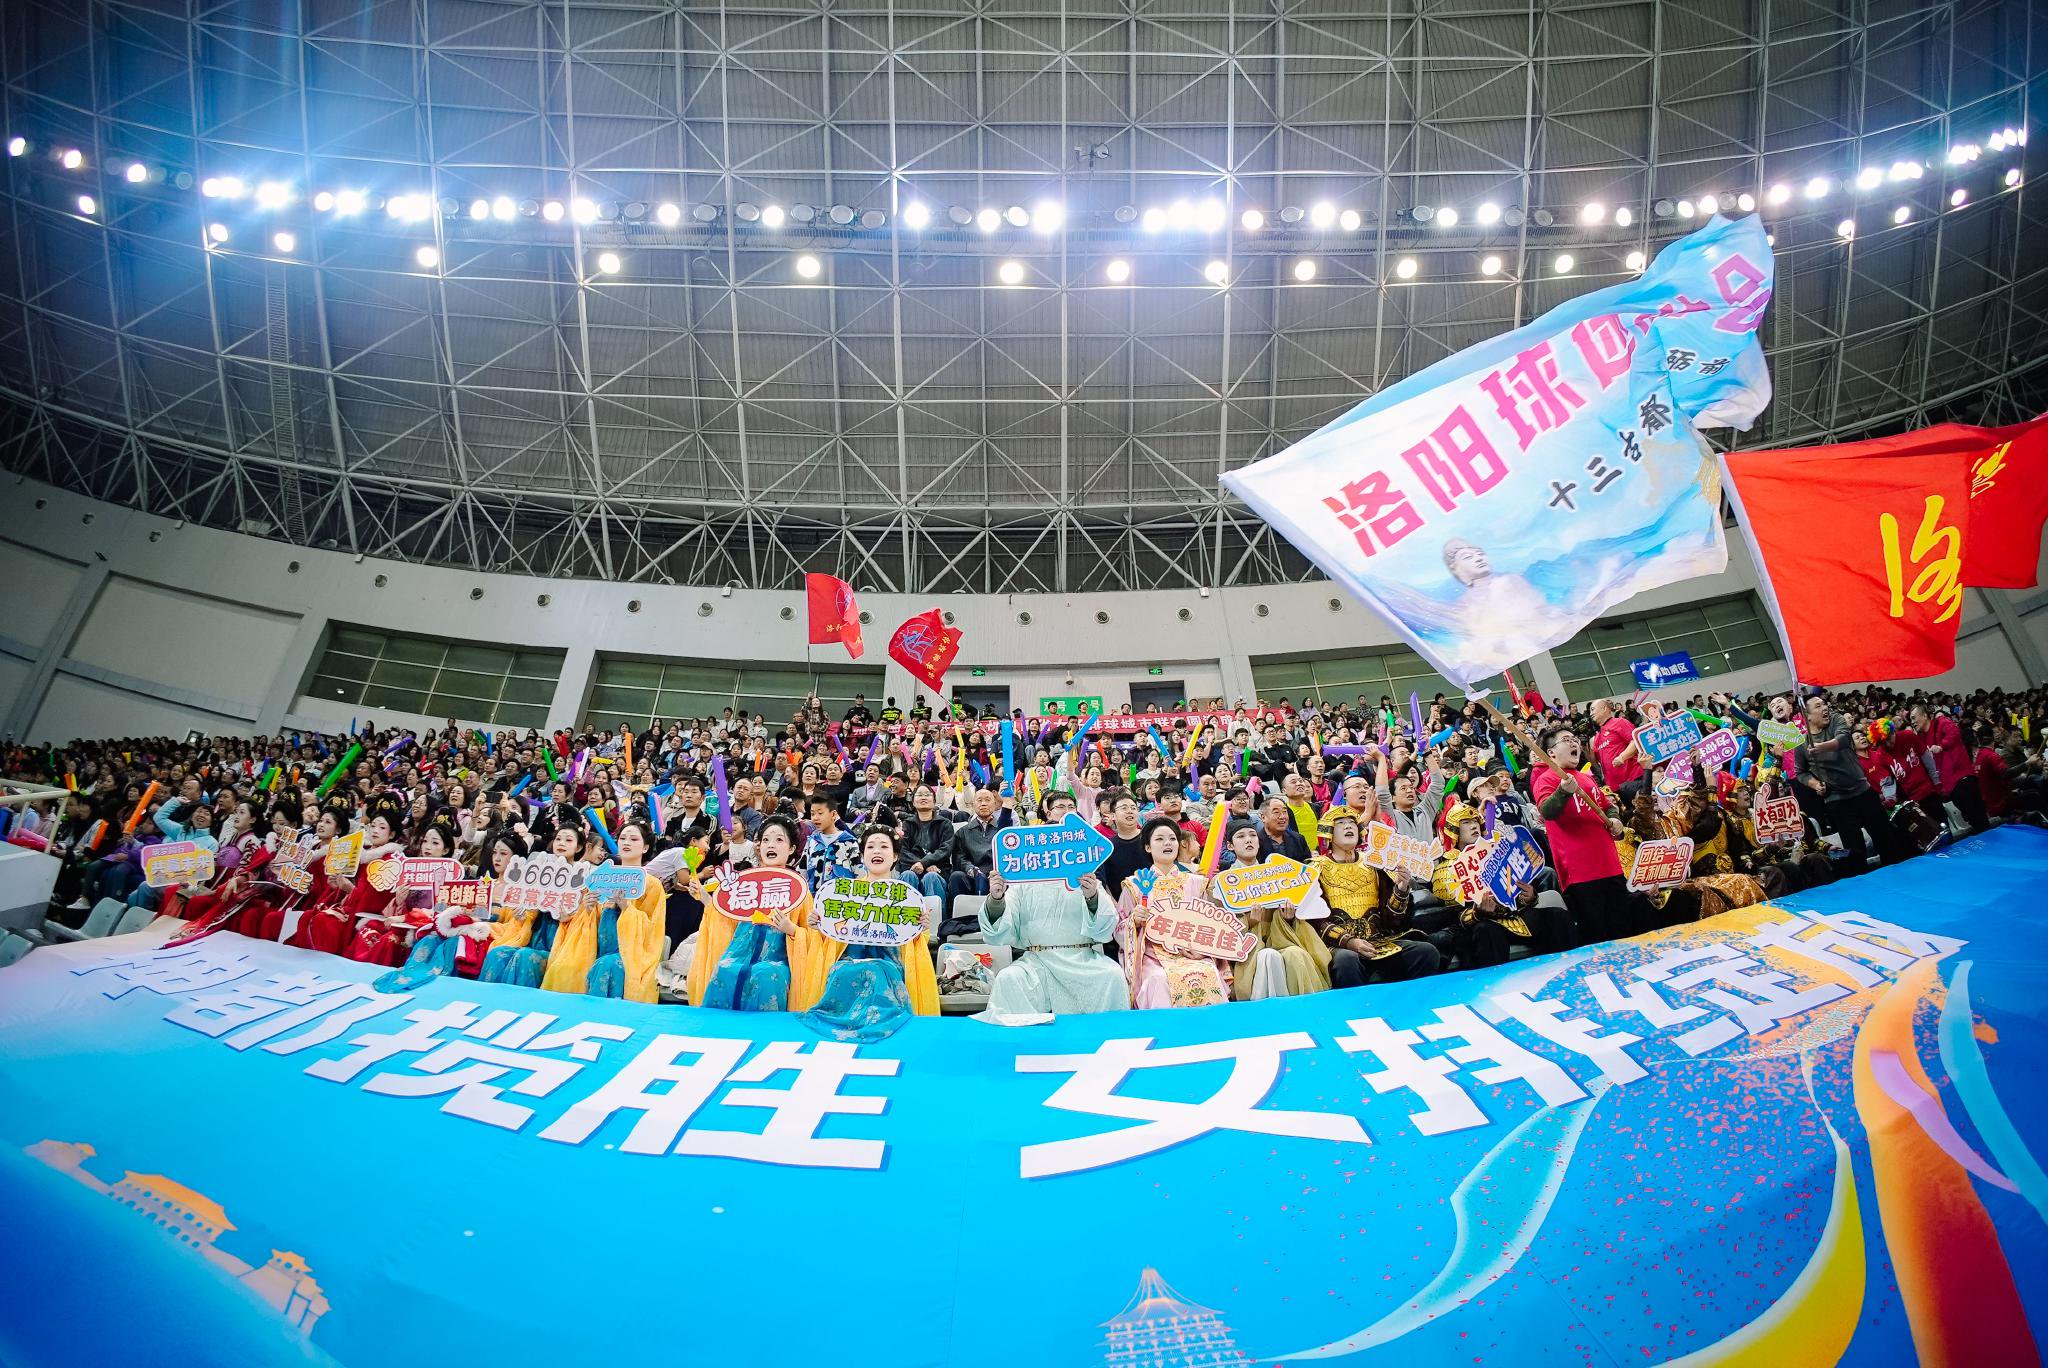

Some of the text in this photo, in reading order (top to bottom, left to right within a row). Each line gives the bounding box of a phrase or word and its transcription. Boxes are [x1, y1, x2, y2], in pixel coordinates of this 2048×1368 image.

[1757, 800, 1797, 825] 大有可为
[1024, 829, 1087, 846] 隋唐洛阳城
[1003, 846, 1101, 873] 为你打Call
[1640, 844, 1690, 864] 团结一心
[280, 863, 313, 892] NICE
[524, 864, 569, 888] 666
[1498, 847, 1532, 897] 必胜
[1634, 860, 1685, 881] 其利断金
[439, 884, 488, 905] 再创新高
[504, 886, 577, 910] 超常发挥
[727, 877, 793, 911] 稳赢
[835, 878, 908, 901] 洛阳女排
[1227, 872, 1312, 903] 为你打Call
[823, 898, 922, 926] 凭实力优秀
[851, 926, 899, 941] 隋唐洛阳城
[1015, 910, 1970, 1179] 女排绽放
